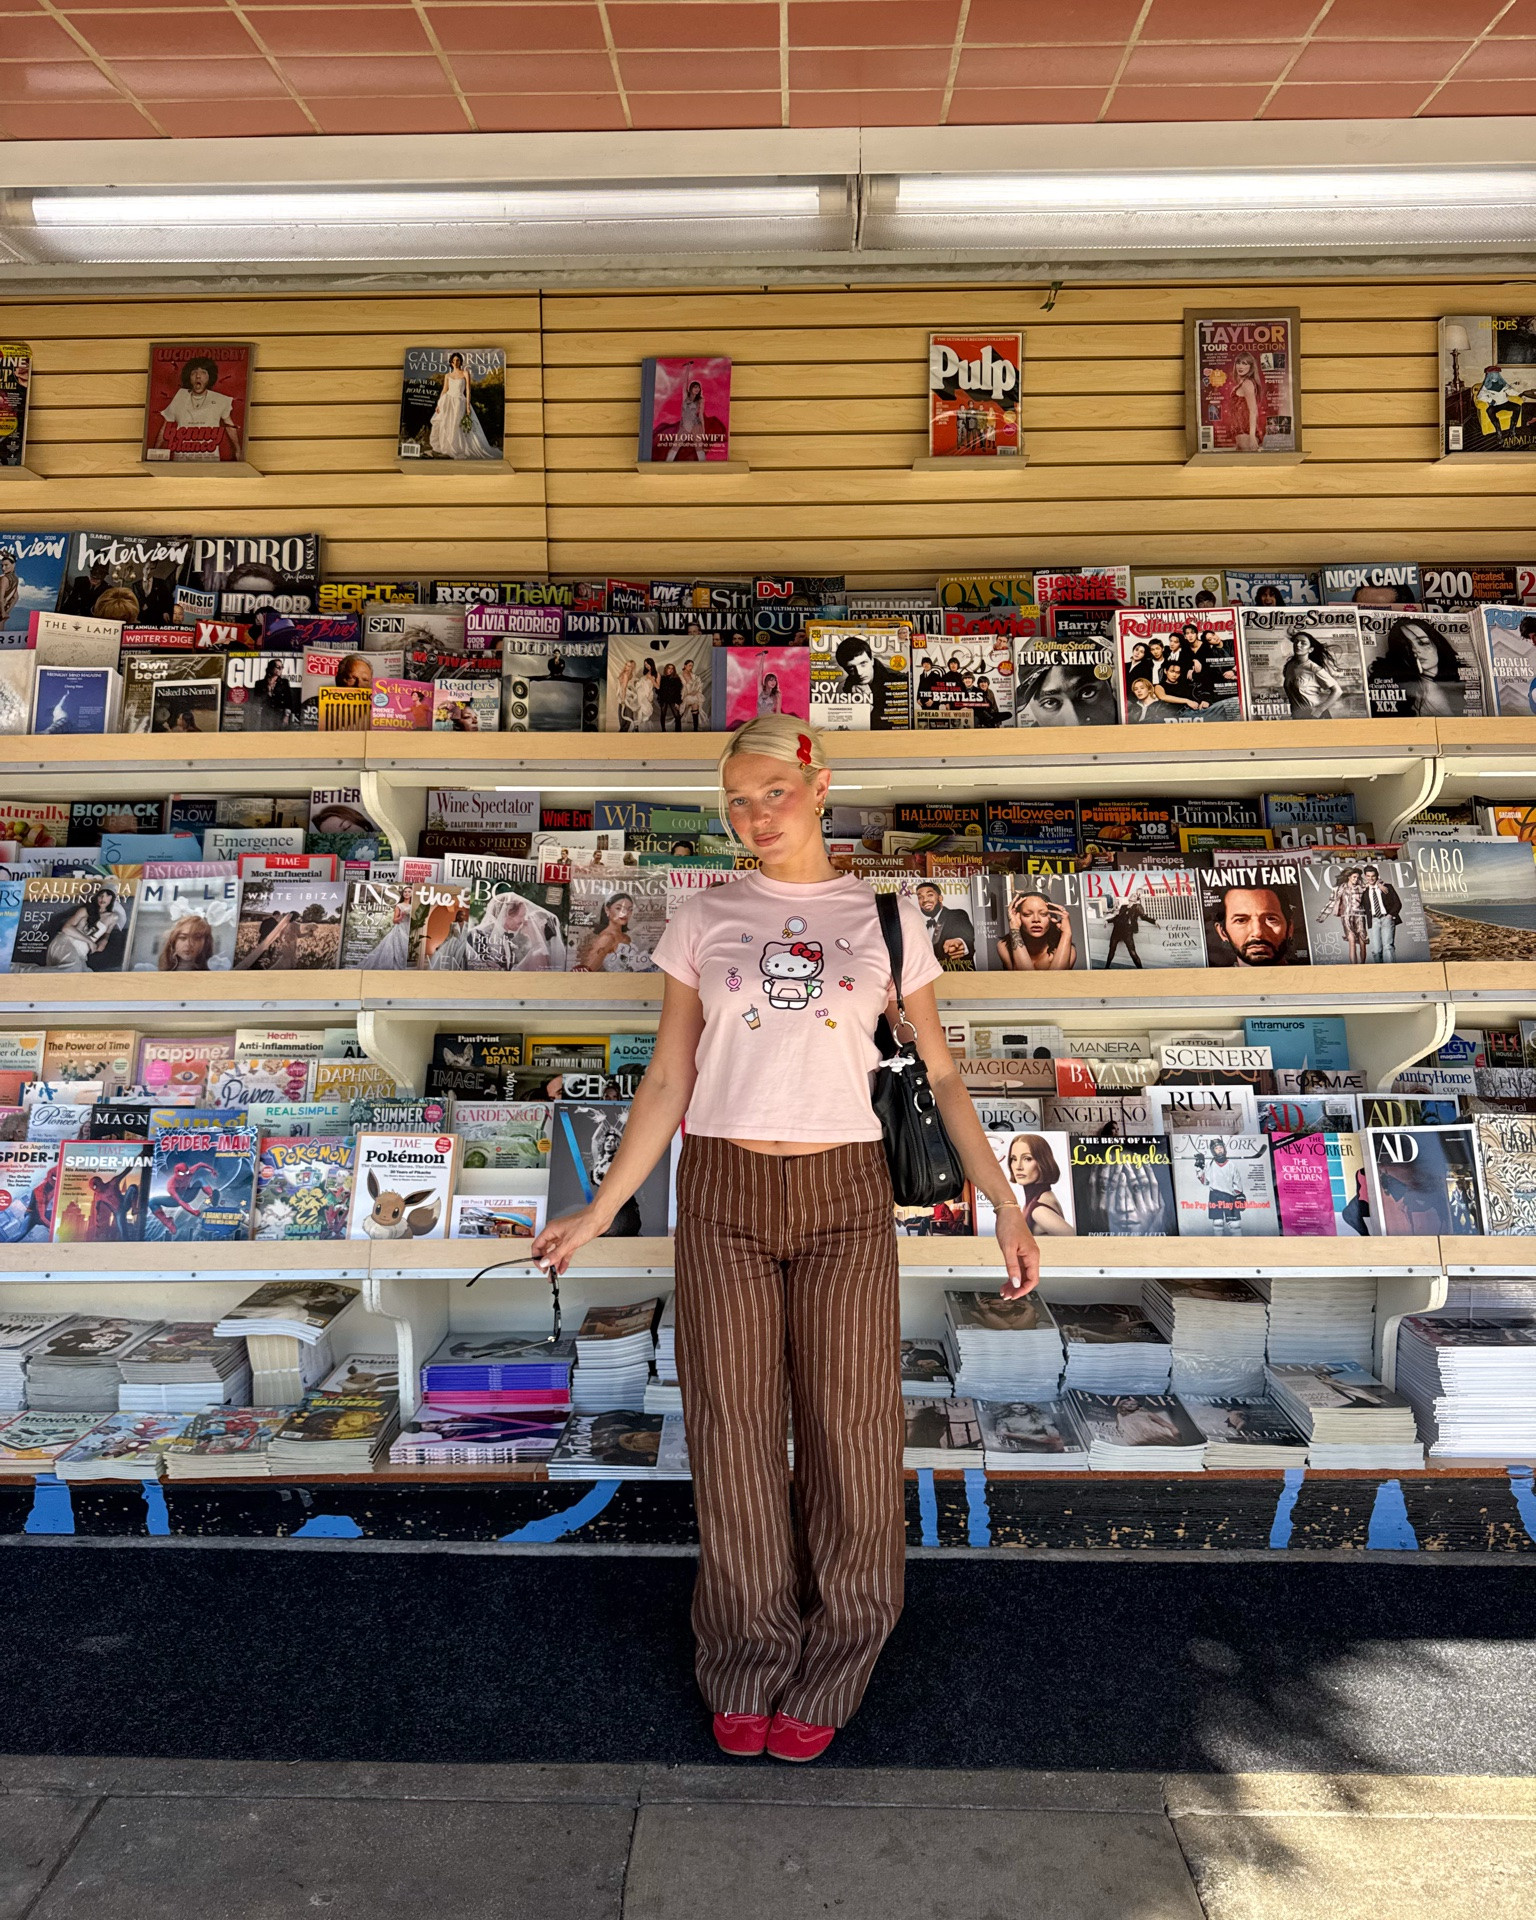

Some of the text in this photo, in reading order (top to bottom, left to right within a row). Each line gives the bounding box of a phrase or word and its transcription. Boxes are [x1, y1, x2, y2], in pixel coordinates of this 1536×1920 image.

[1202, 328, 1285, 343] TAYLOR
[1203, 342, 1285, 352] TOUR COLLECTION
[930, 344, 1016, 399] Pulp
[658, 433, 726, 443] TAYLOR SWIFT
[77, 533, 189, 571] Interview
[193, 537, 304, 573] PEDRO
[1037, 575, 1116, 589] SIOUXSIE
[1325, 567, 1418, 588] NICK CAVE
[1472, 572, 1505, 581] Greatest
[1161, 578, 1195, 590] People
[1424, 572, 1472, 598] 200
[1473, 581, 1513, 590] Americana
[319, 584, 397, 599] SIGHT
[941, 581, 1033, 607] OASIS
[1037, 586, 1127, 602] BANSHEES
[1473, 590, 1501, 598] Albums
[179, 590, 214, 606] MUSIC
[1138, 595, 1193, 609] BEATLES
[484, 607, 509, 616] UNOFFICIAL
[511, 608, 524, 616] FAN'S
[370, 618, 404, 633] SPIN
[467, 614, 560, 633] OLIVIA RODRIGO
[567, 615, 655, 633] BOB DYLAN
[660, 612, 751, 630] METALLICA
[945, 612, 1037, 636] Bowie
[45, 620, 120, 636] THE LAMP
[1020, 650, 1112, 666] TUPAC SHAKUR
[1493, 658, 1530, 667] GRACIE
[130, 661, 168, 670] down
[1493, 667, 1534, 676] ABRAMS
[134, 671, 168, 680] beat
[439, 679, 495, 690] Reader's
[811, 682, 839, 694] JOY
[157, 688, 180, 698] Naked
[182, 687, 188, 696] Is
[189, 686, 216, 696] Normal
[933, 692, 983, 702] BEATLES
[811, 693, 873, 704] DIVISION
[1251, 703, 1291, 715] CHARLI
[1376, 701, 1398, 712] XCX
[373, 718, 413, 729] GENOUX
[313, 789, 360, 804] BETTER
[73, 804, 159, 816] BIOHACK
[436, 792, 534, 818] Wine Spectator
[1275, 801, 1348, 813] 30-Minute
[172, 810, 213, 822] SLOW
[543, 812, 570, 826] WINE
[901, 809, 979, 821] HALLOWEEN
[989, 807, 1075, 820] Halloween
[1082, 810, 1169, 828] Pumpkins
[1172, 805, 1257, 827] Pumpkin
[1290, 812, 1334, 823] MEALS
[73, 818, 158, 826] YOURSELF
[1040, 825, 1073, 833] Thrilling
[1140, 824, 1167, 835] 108
[215, 835, 293, 848] Emergence
[425, 836, 527, 848] CIGAR & SPIRITS
[1281, 825, 1367, 847] delish
[931, 855, 983, 865] Southern Living
[1142, 856, 1184, 865] allrecipes
[1418, 848, 1464, 873] CABO
[251, 870, 322, 878] Most Influential
[451, 859, 537, 882] TEXAS OBSERVER
[1201, 866, 1298, 887] VANITY FAIR
[572, 879, 668, 896] WEDDINGS
[1087, 872, 1192, 898] BAZAAR
[1422, 873, 1468, 892] LIVING
[248, 891, 338, 900] WHITE IBIZA
[24, 911, 54, 921] BEST
[19, 931, 50, 942] 2026
[1313, 932, 1340, 945] JUST
[1315, 944, 1342, 955] KIDS
[1251, 1020, 1304, 1030] intramuros
[267, 1032, 297, 1040] Health
[48, 1042, 130, 1050] The Power of Time
[239, 1042, 324, 1051] Anti-Inflammation
[1070, 1042, 1141, 1053] MANERA
[486, 1056, 520, 1065] BRAIN
[1165, 1049, 1267, 1067] SCENERY
[959, 1060, 1053, 1075] MAGICASA
[433, 1070, 485, 1089] IMAGE
[1168, 1090, 1235, 1112] RUM
[266, 1106, 339, 1116] REAL SIMPLE
[373, 1108, 424, 1123] SUMMER
[982, 1110, 1037, 1123] DIEGO
[1051, 1107, 1147, 1124] ANGELENO
[1369, 1101, 1407, 1127] AD
[161, 1134, 251, 1152] SPIDER-MAN
[393, 1139, 421, 1148] TIME
[1377, 1134, 1419, 1164] AD
[65, 1156, 153, 1167] SPIDER-MAN
[366, 1150, 445, 1164] Pokémon
[1071, 1144, 1172, 1169] Los Angeles
[1293, 1158, 1309, 1166] THE
[1280, 1166, 1323, 1175] SCIENTIST'S
[1283, 1174, 1322, 1182] CHILDREN
[22, 1416, 99, 1424] MONOPOLY
